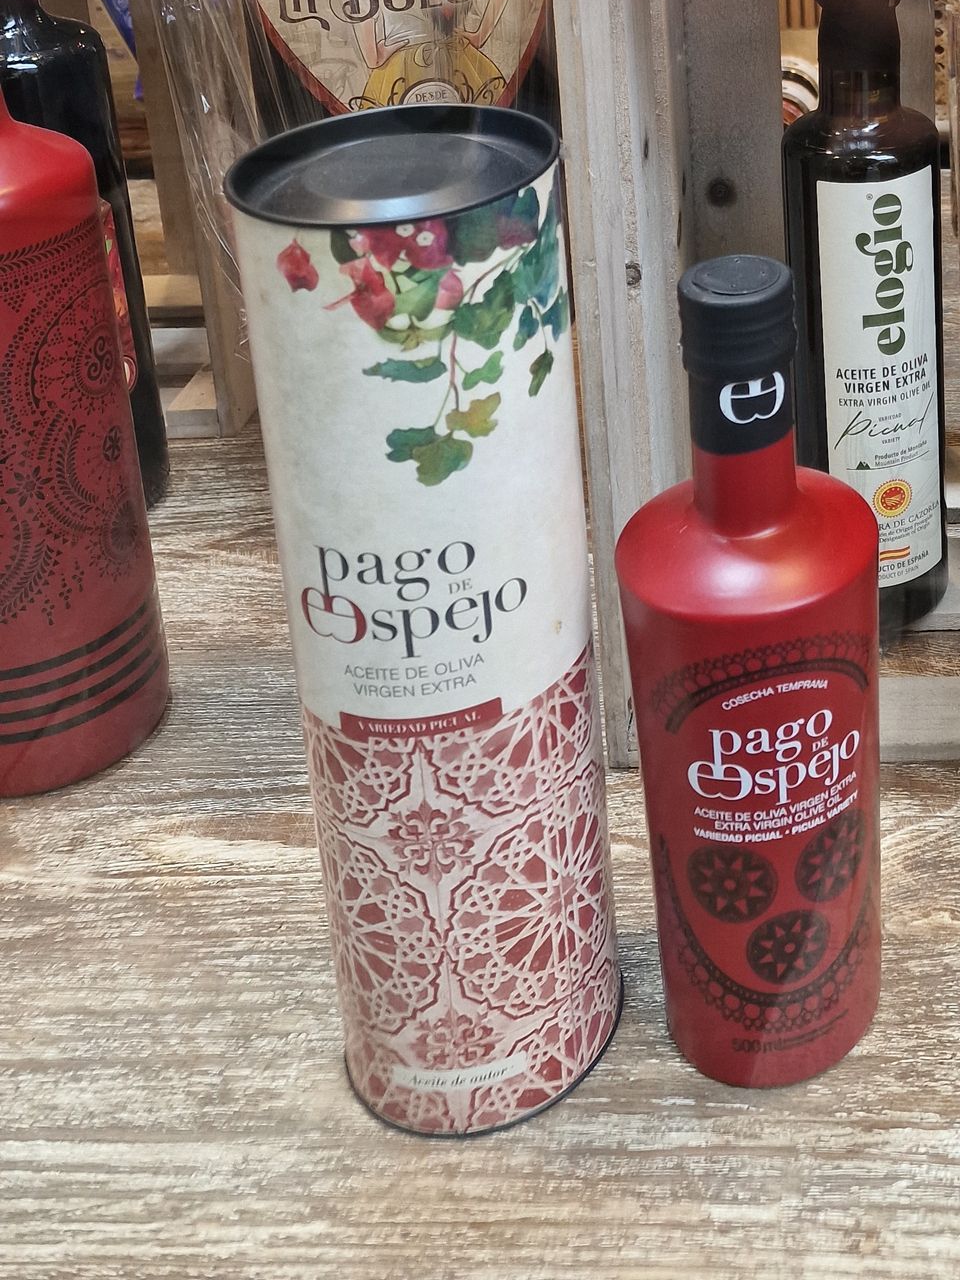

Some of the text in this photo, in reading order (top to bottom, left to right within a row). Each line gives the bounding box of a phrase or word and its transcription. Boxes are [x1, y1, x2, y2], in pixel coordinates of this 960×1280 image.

[415, 90, 448, 103] DESDE
[856, 193, 913, 355] elogio
[836, 352, 928, 380] ACEITE DE OLIVA
[839, 381, 930, 407] EXTRA VIRGIN OLIVE OIL
[844, 368, 926, 394] VIRGEN EXTRA
[834, 392, 934, 450] Picual
[315, 540, 475, 608] pago
[448, 579, 473, 595] DE
[344, 653, 485, 680] ACEITE DE OLIVA
[353, 674, 477, 698] VIRGEN EXTRA
[722, 679, 828, 711] COSECHA TEMPRANA
[708, 709, 833, 772] pago
[812, 737, 828, 752] DE
[694, 771, 857, 821] ACEITE DE OLIVA VIRGEN EXTRA
[715, 795, 842, 832] EXTRA VIRGIN OLIVE OIL
[411, 1068, 507, 1087] Aceite de autor
